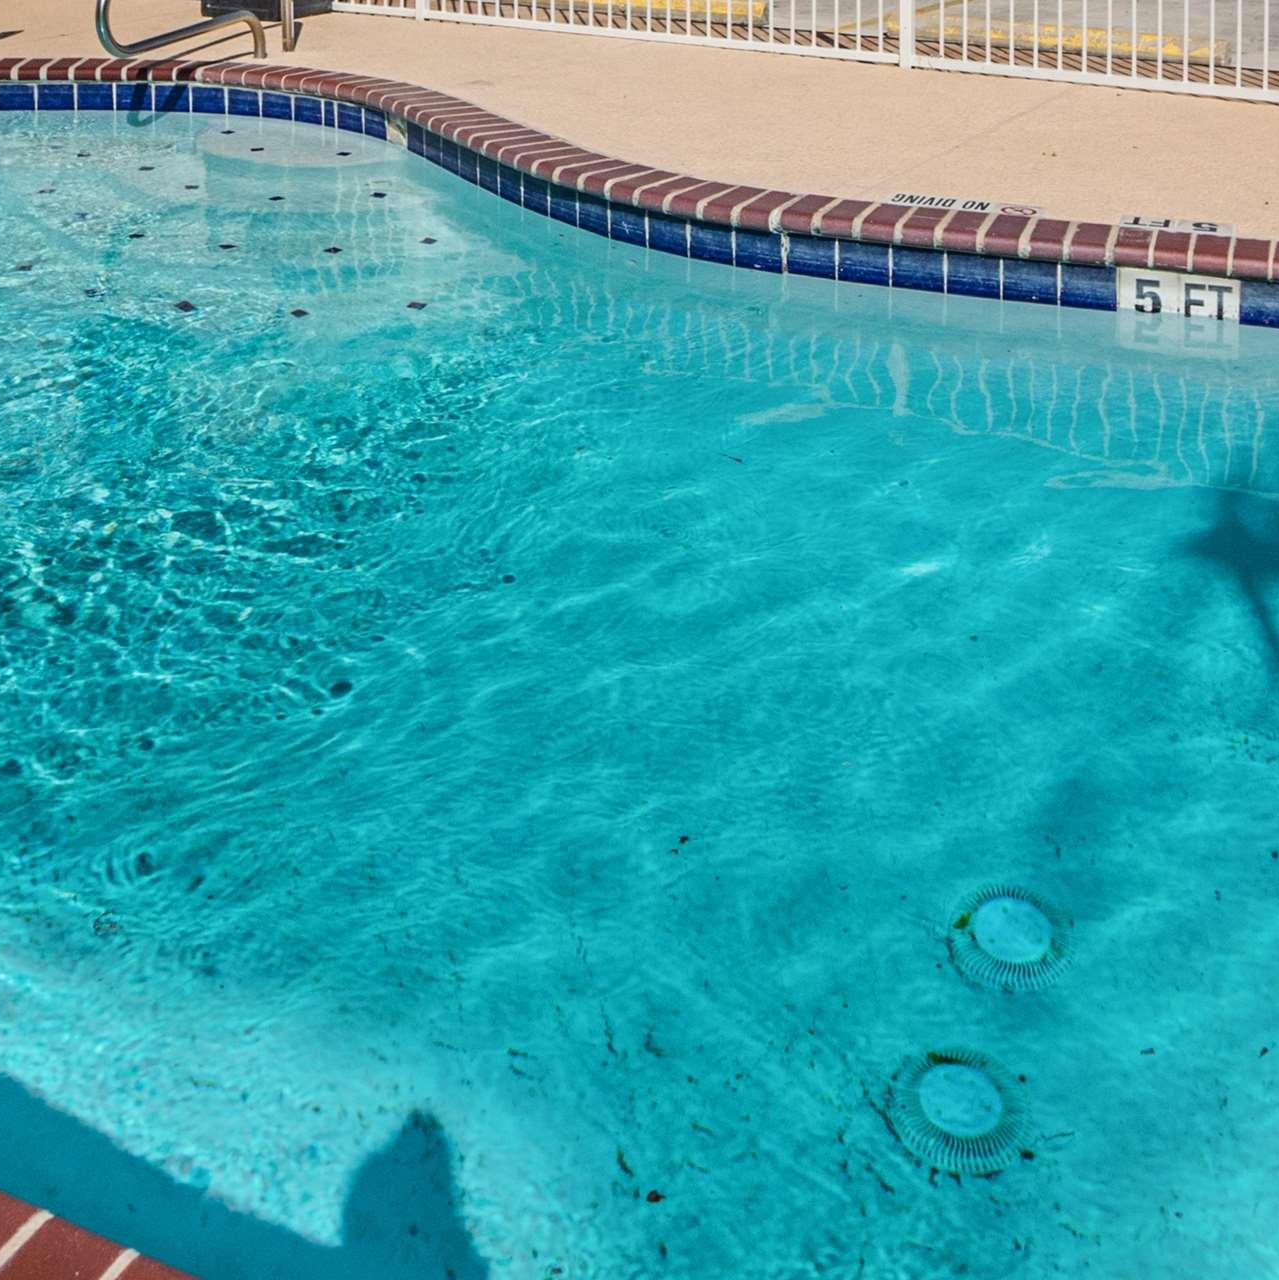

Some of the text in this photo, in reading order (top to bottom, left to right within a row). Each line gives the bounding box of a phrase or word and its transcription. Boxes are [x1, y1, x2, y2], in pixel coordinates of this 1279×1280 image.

[891, 193, 991, 211] NO DIVING
[1134, 278, 1234, 321] 5 FT
